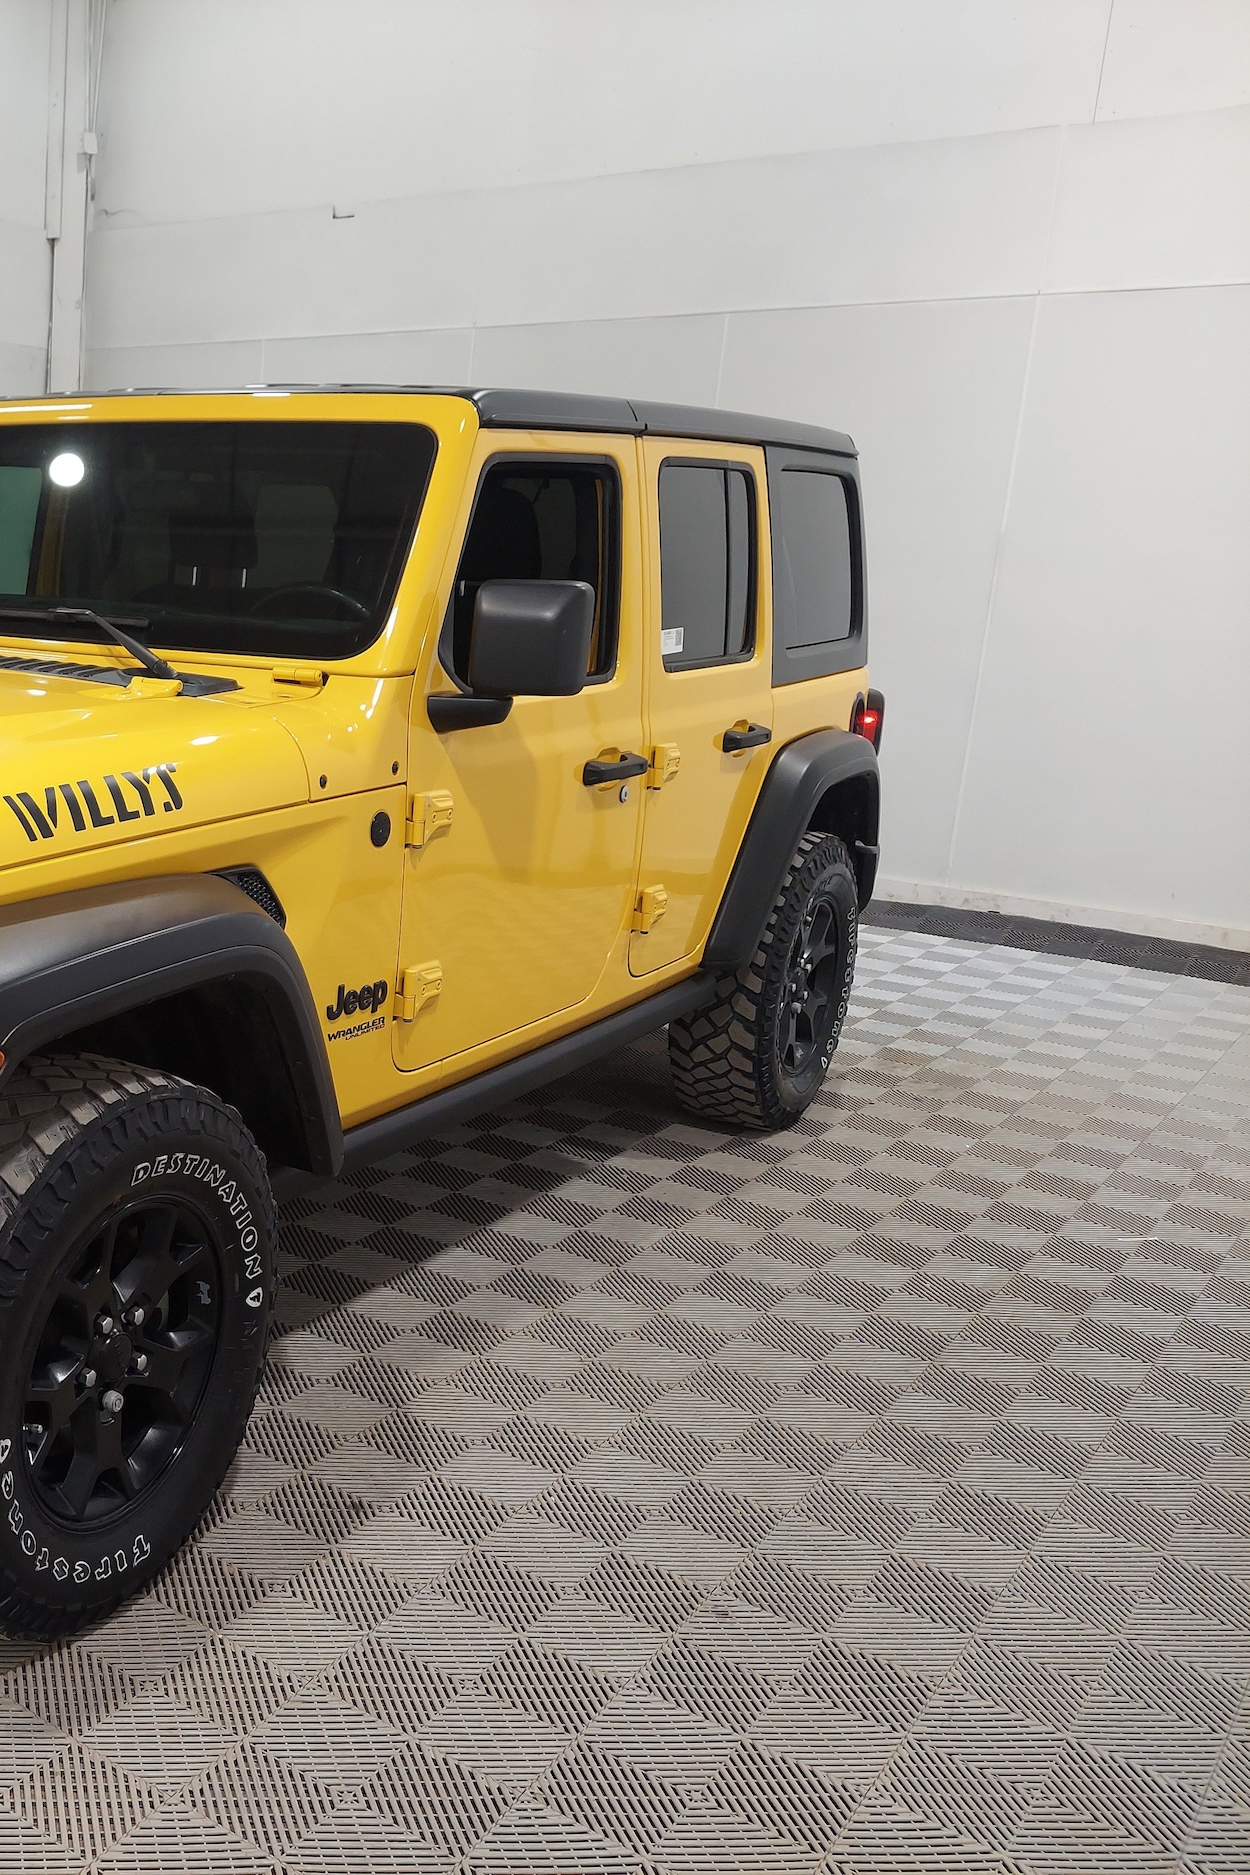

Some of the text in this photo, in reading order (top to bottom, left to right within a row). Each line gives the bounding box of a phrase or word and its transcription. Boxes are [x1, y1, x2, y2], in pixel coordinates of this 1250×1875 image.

[2, 763, 183, 841] WILLYS
[326, 979, 388, 1021] Jeep
[327, 1016, 385, 1042] WRANGLER
[131, 1152, 263, 1279] DESTINATION
[2, 1471, 150, 1584] Firestone
